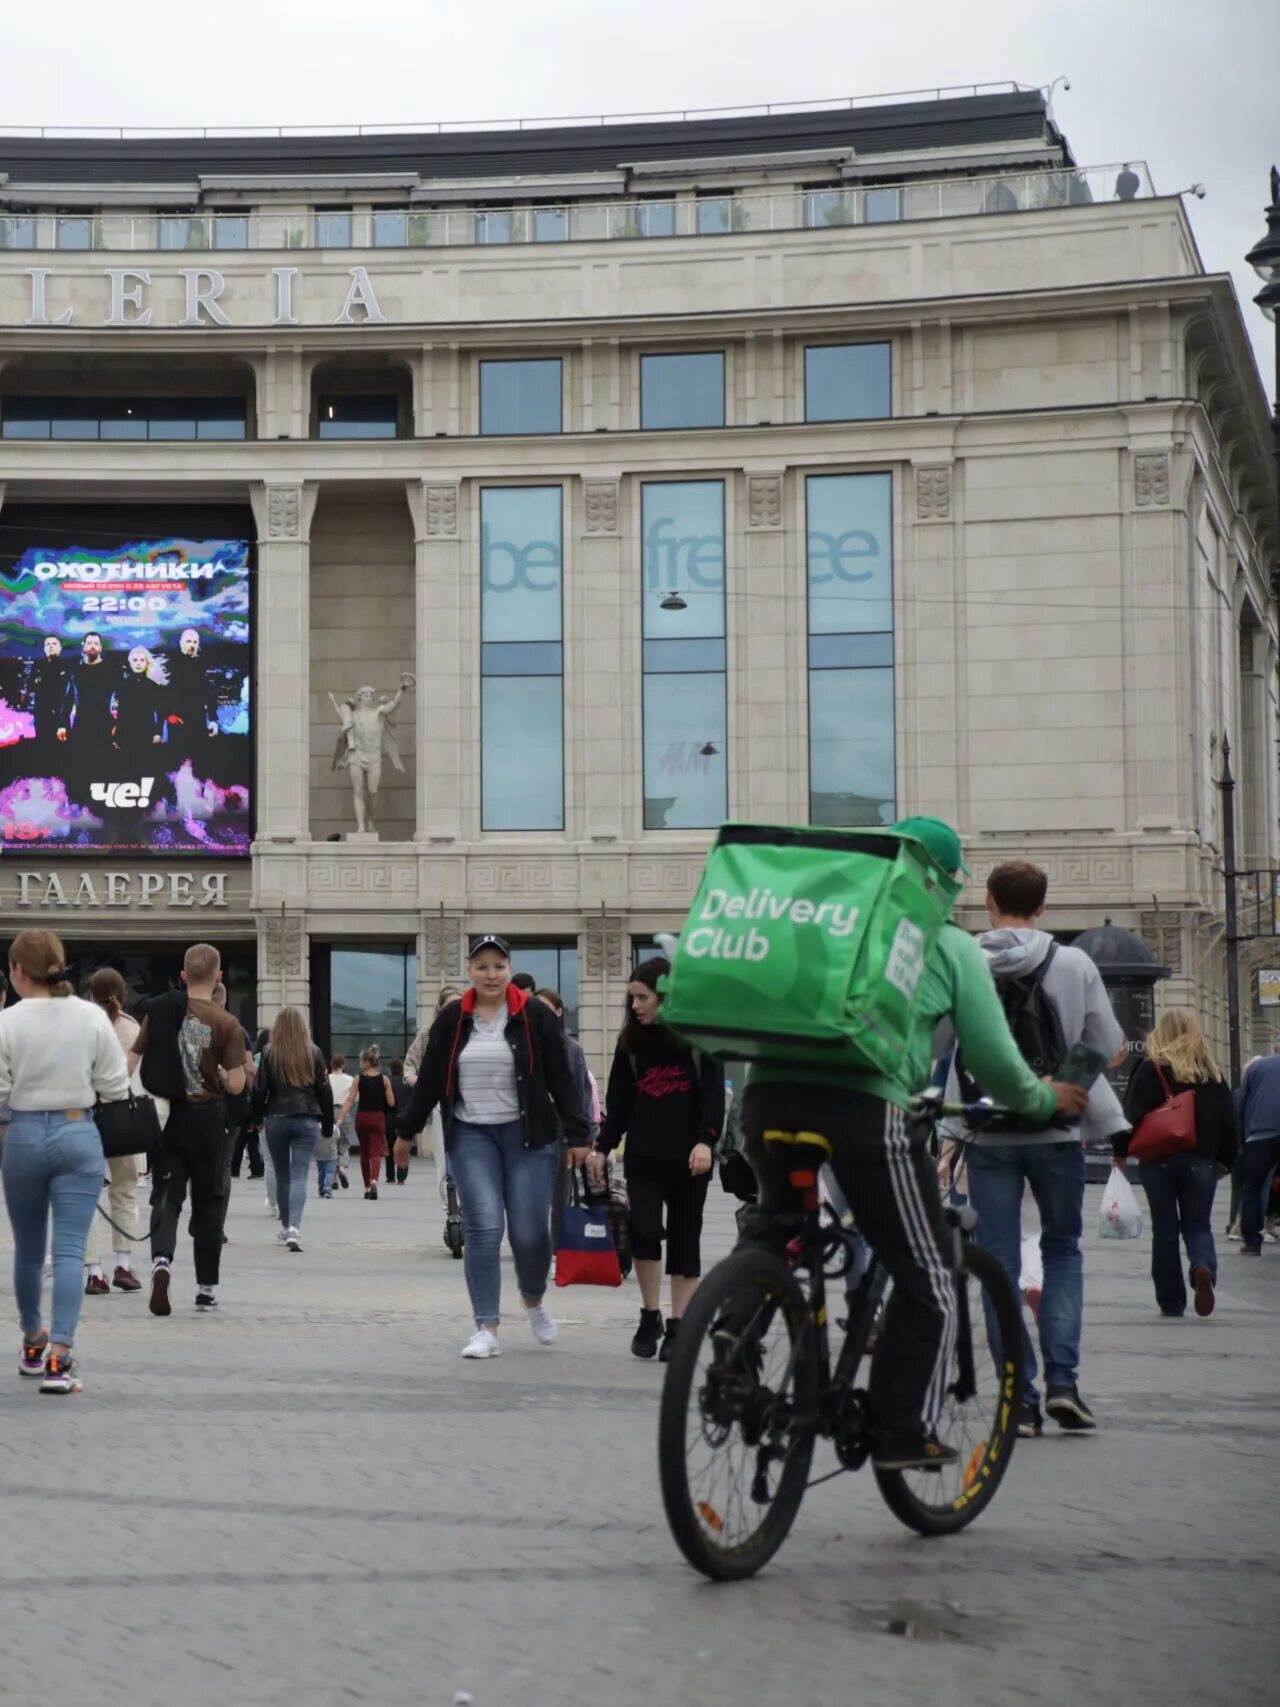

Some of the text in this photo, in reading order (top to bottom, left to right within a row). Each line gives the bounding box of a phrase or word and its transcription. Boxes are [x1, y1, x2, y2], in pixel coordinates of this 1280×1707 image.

[34, 562, 215, 580] ОХОТНИКИ
[483, 522, 560, 593] be
[82, 597, 167, 612] 22:00
[17, 872, 228, 906] ГАЛЕРЕЯ
[700, 888, 859, 936] Delivery
[685, 927, 769, 961] Club
